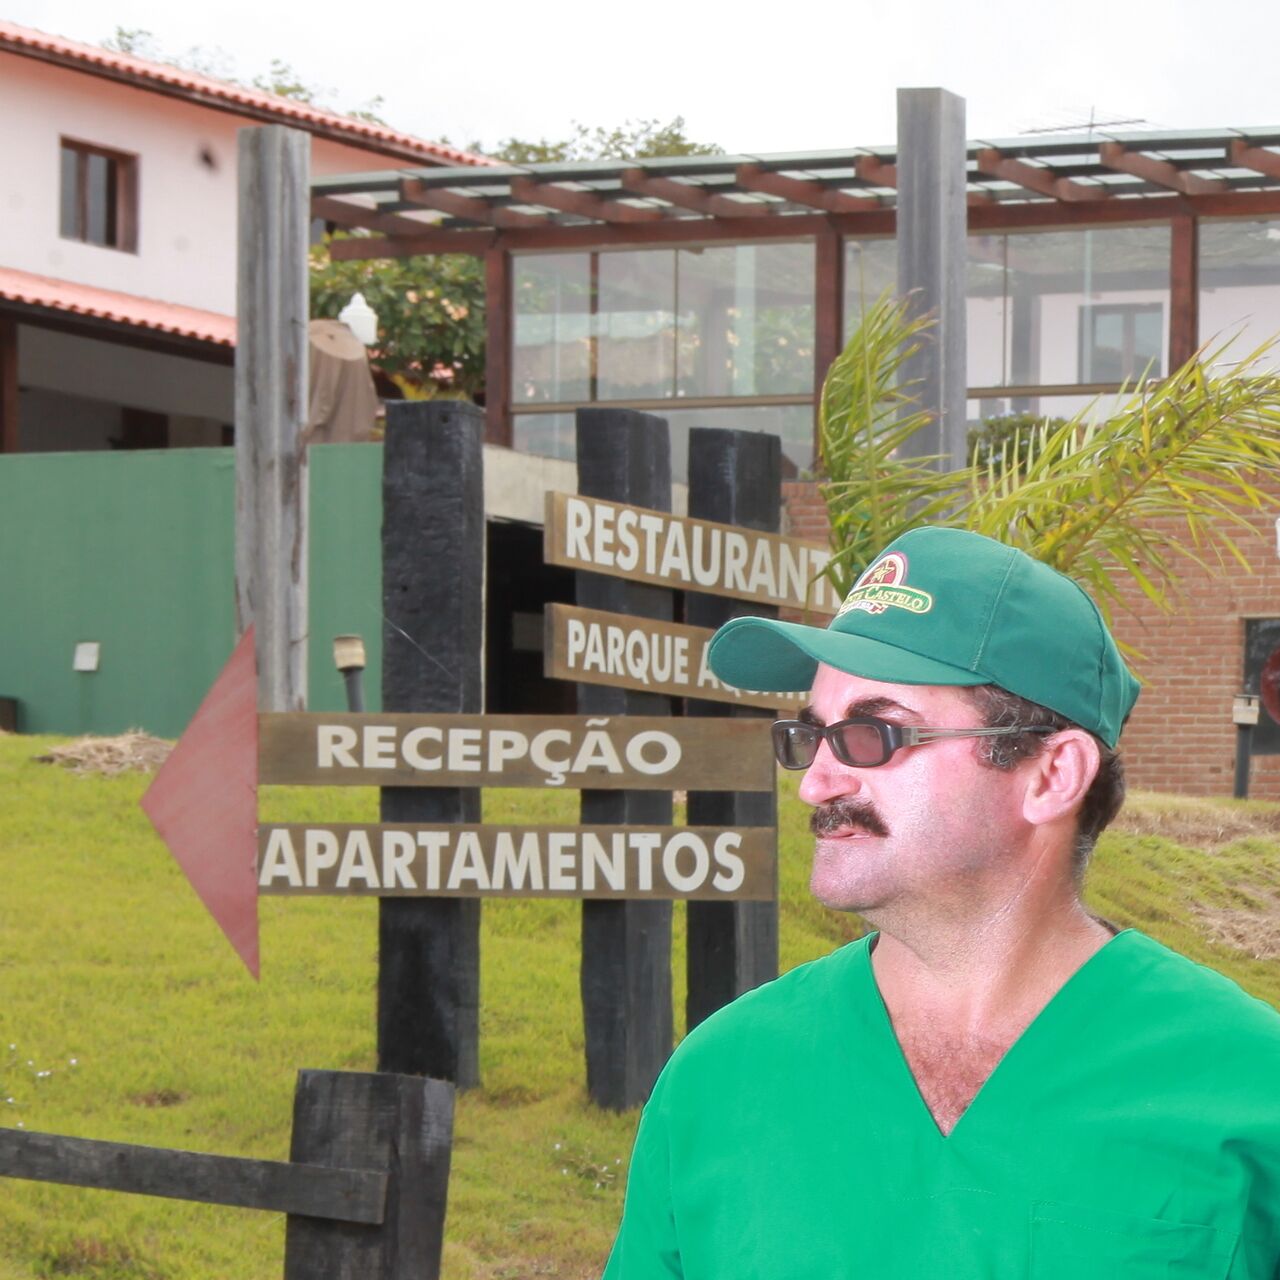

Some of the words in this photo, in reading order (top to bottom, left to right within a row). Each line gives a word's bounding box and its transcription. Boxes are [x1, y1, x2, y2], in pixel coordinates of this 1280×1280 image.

[864, 585, 924, 609] CASTELO
[567, 619, 689, 684] PARQUE
[317, 717, 682, 786] RECEPÇÃO
[258, 828, 745, 892] APARTAMENTOS
